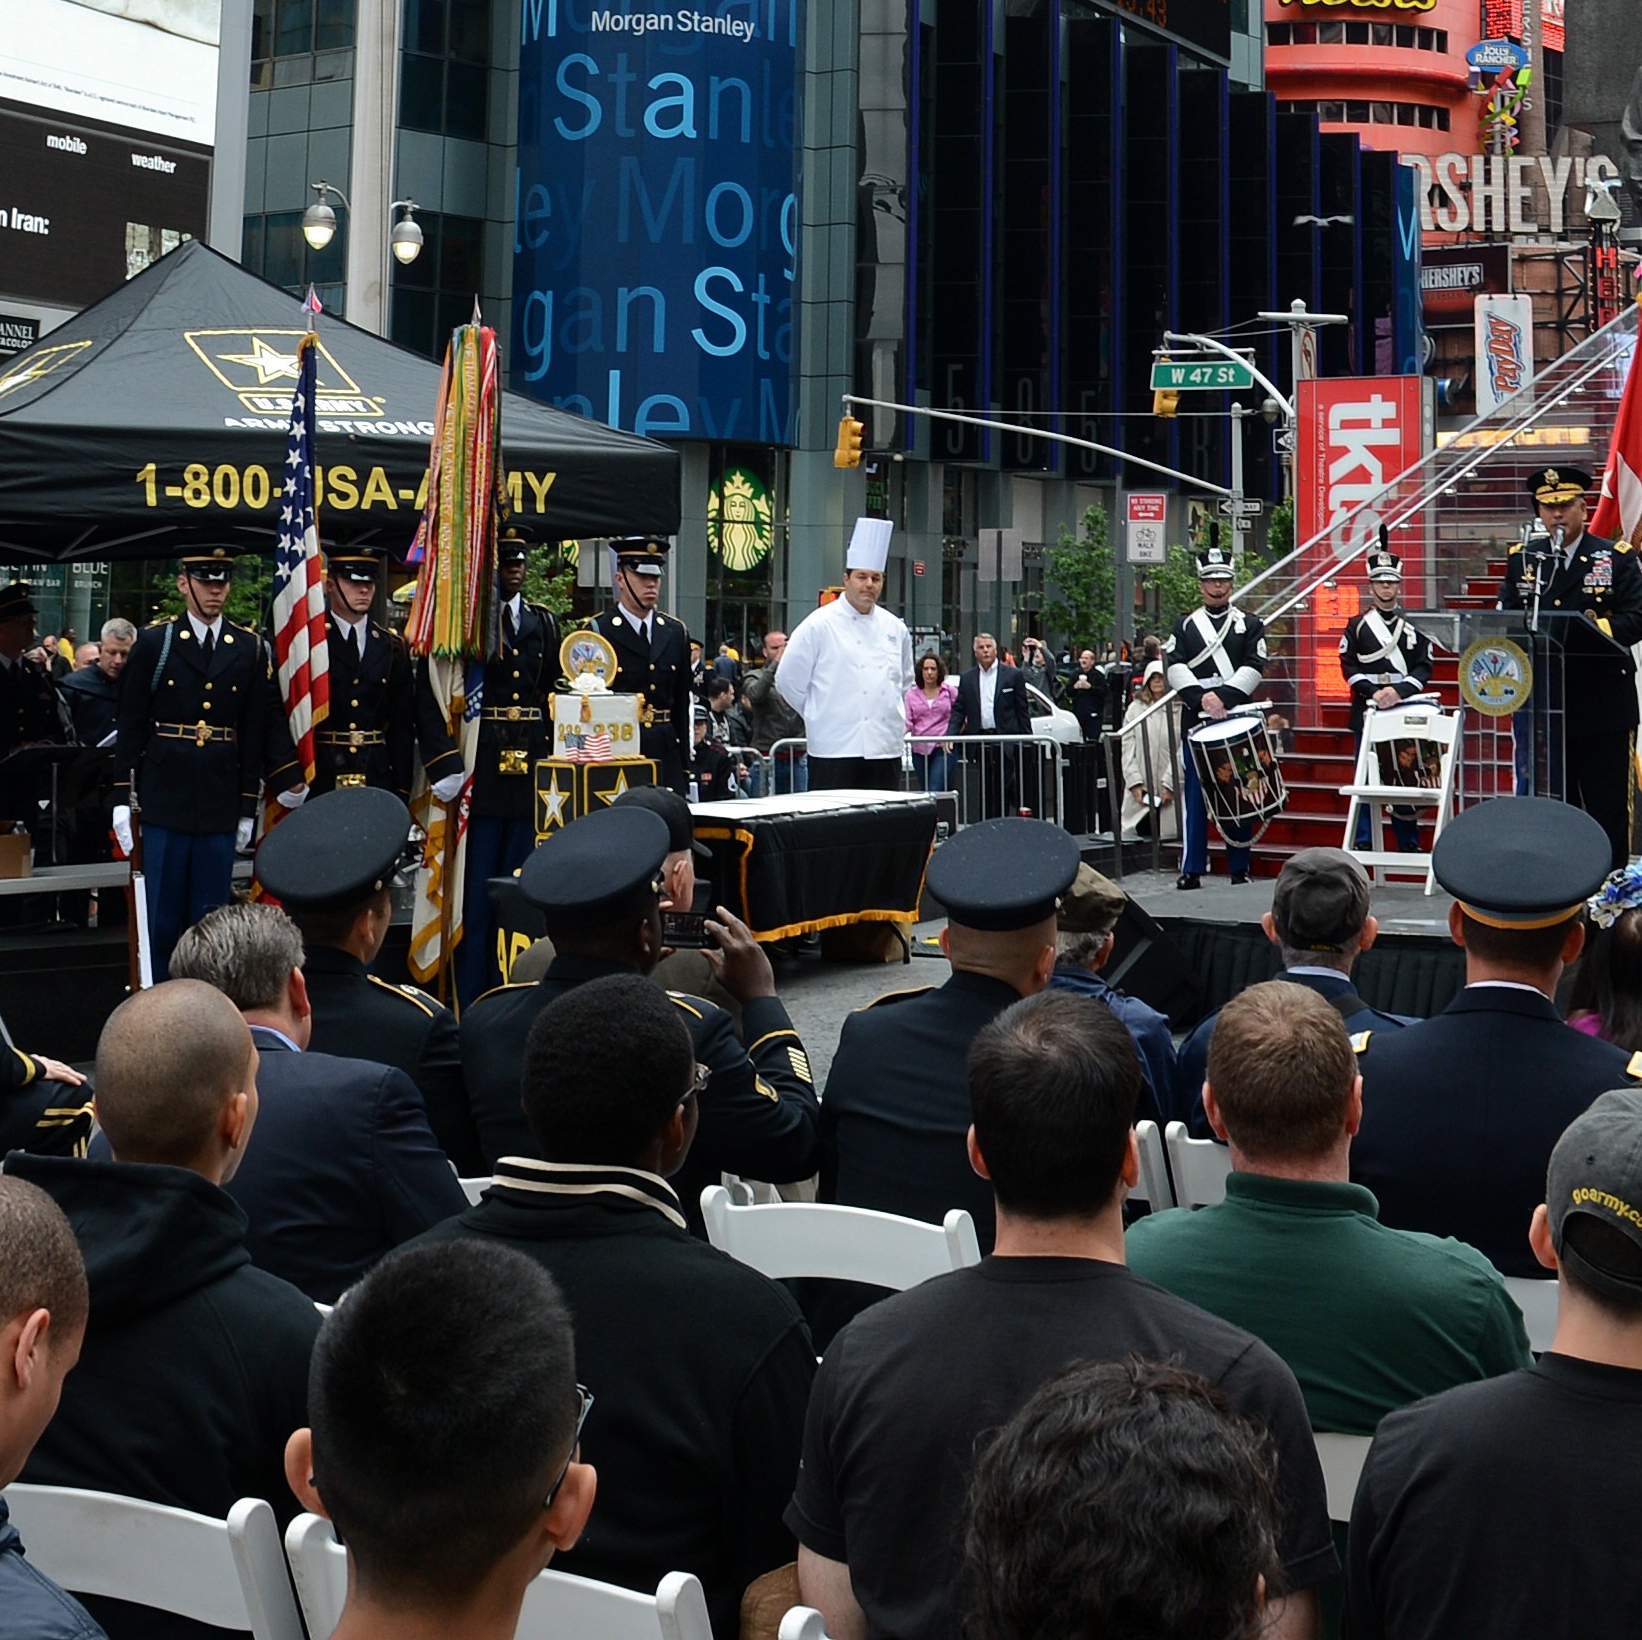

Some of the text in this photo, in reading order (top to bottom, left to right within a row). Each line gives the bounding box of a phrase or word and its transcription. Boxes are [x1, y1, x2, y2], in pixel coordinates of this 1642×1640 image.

[591, 9, 755, 43] Morgan Stanley
[1475, 53, 1518, 66] RANCHER
[1483, 45, 1510, 57] JOLLY
[47, 133, 88, 156] mobile
[131, 151, 177, 176] weather
[11, 205, 50, 236] Iran:
[1171, 367, 1236, 384] W 47 St
[1329, 393, 1401, 563] tkts
